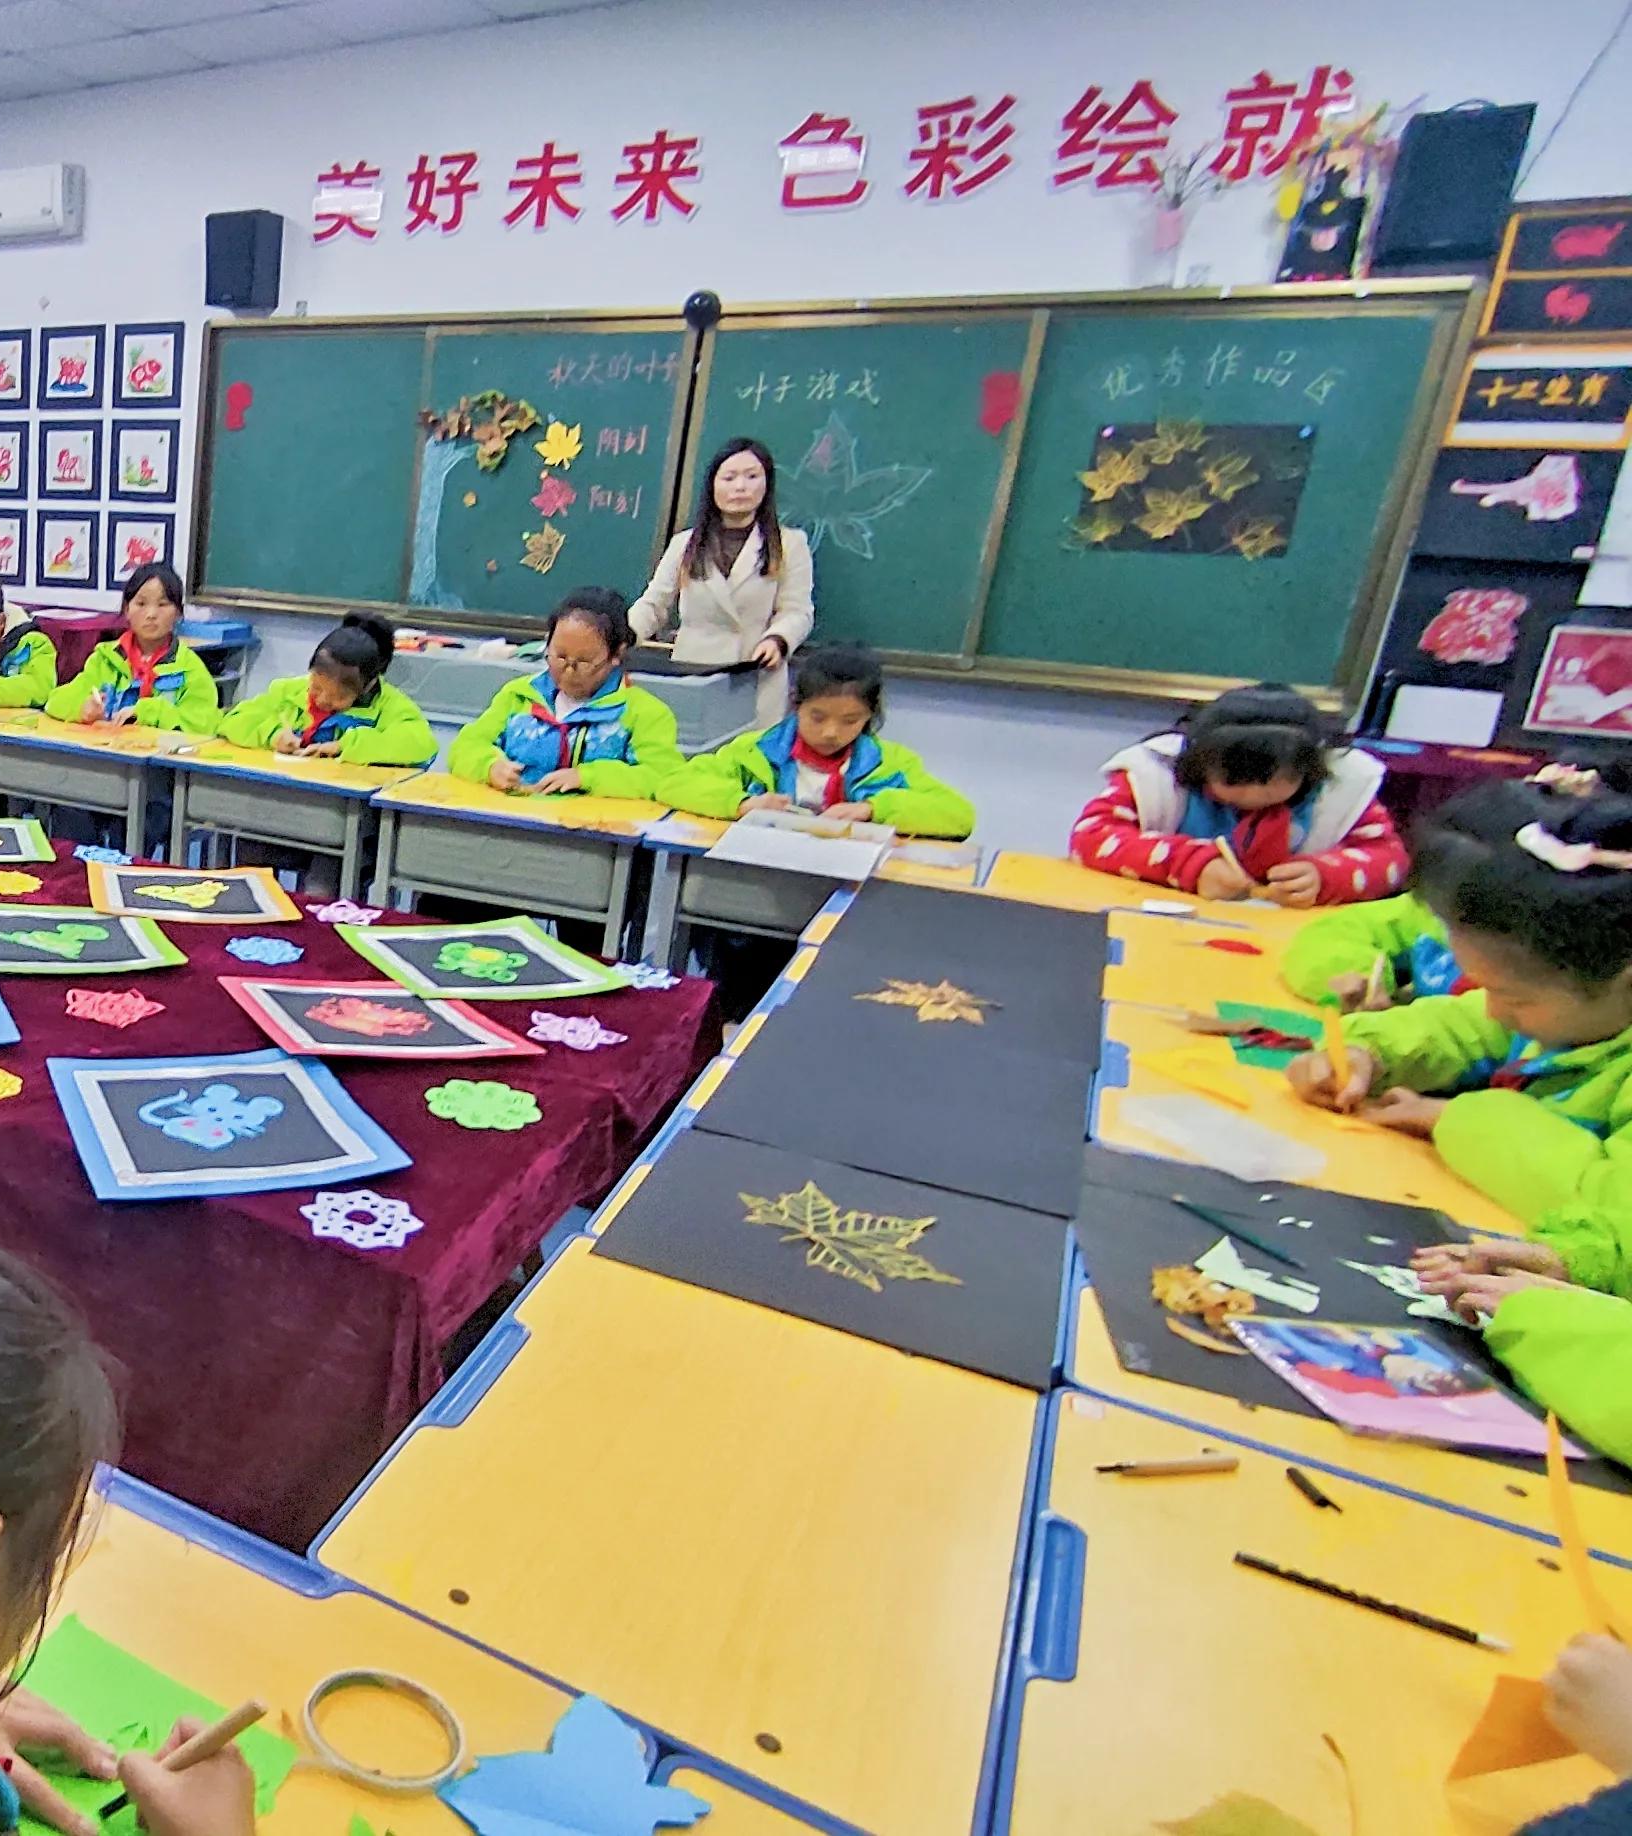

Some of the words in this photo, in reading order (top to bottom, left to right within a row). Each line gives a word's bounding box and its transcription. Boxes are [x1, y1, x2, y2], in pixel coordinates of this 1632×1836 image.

[313, 129, 700, 243] 美好未来
[779, 64, 1358, 208] 色彩绘就
[1477, 373, 1610, 408] 十二生肖
